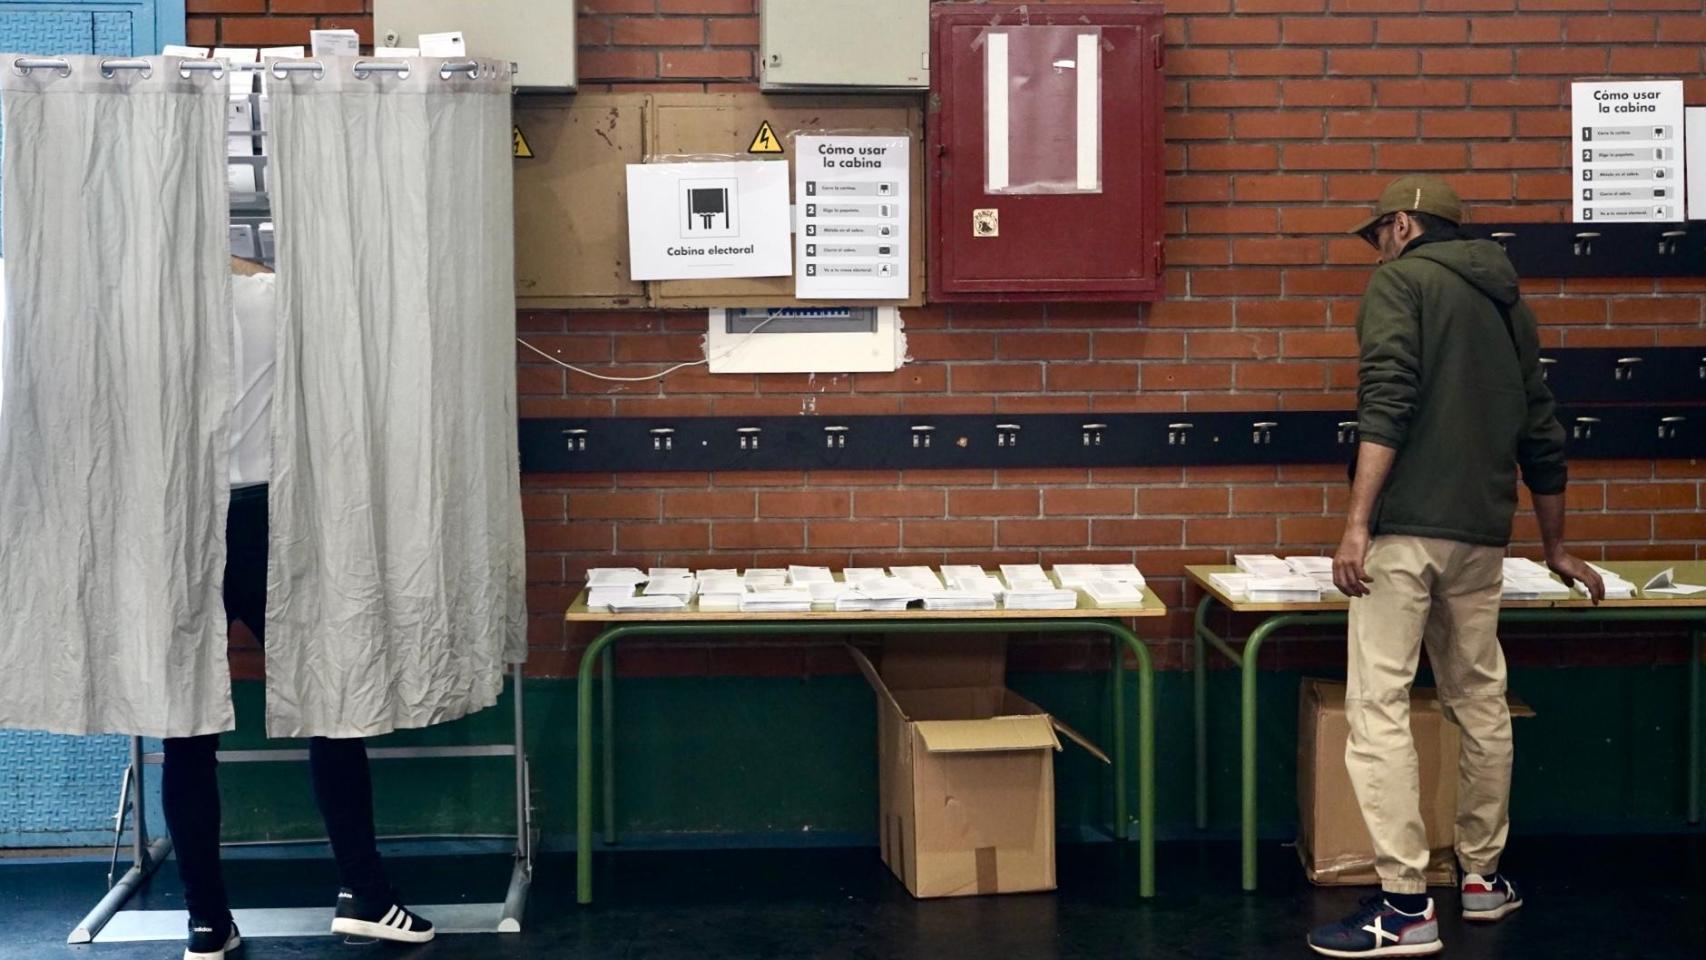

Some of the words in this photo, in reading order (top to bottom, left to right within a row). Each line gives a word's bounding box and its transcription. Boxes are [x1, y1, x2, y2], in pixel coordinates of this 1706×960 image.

[1593, 89, 1629, 101] Cómo
[1633, 91, 1661, 100] usar
[1598, 102, 1610, 113] la
[1614, 101, 1656, 113] cabina
[818, 144, 855, 155] Cómo
[858, 146, 887, 155] usar
[823, 156, 835, 168] la
[838, 156, 882, 168] cabina
[666, 246, 705, 256] Cabina
[707, 244, 754, 255] electoral
